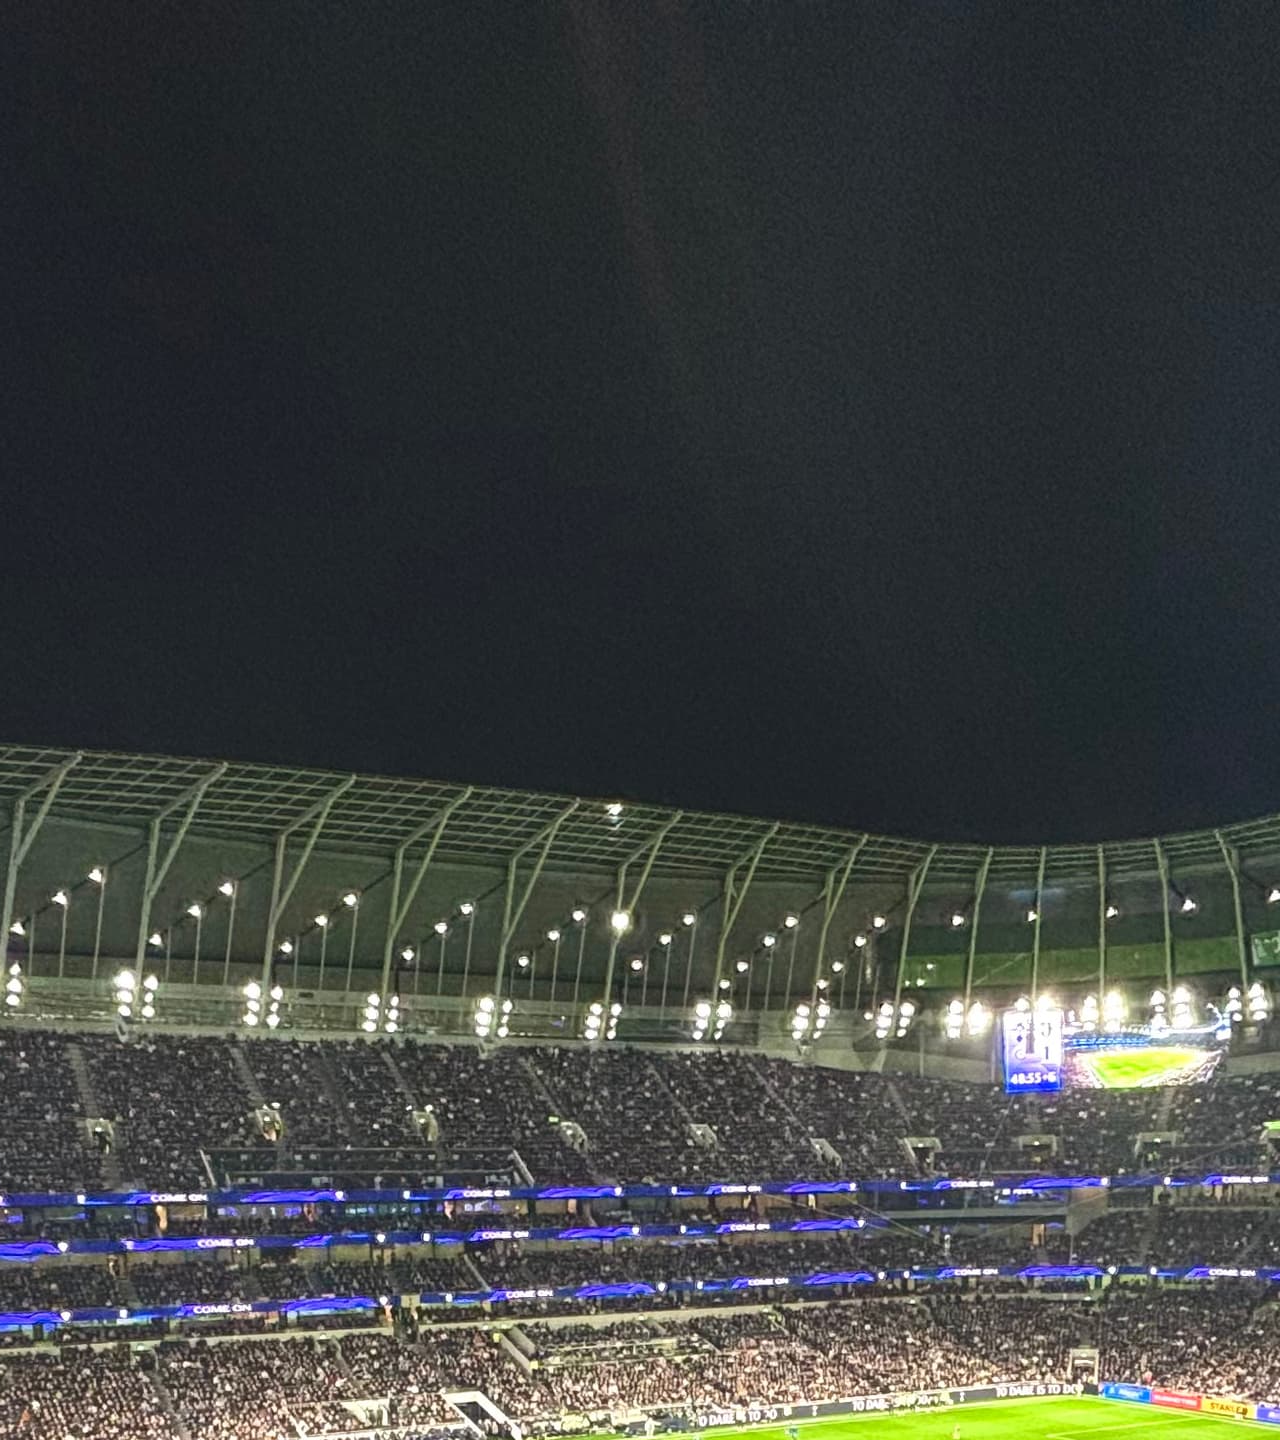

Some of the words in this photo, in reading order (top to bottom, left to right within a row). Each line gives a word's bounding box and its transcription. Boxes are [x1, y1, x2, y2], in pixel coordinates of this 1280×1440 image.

[232, 1303, 252, 1312] ON
[995, 1386, 1006, 1398] TO
[1008, 1385, 1035, 1396] DARE
[1036, 1384, 1046, 1394] IS
[1048, 1384, 1061, 1394] TO
[853, 1400, 865, 1411] TO
[749, 1412, 760, 1422] TO
